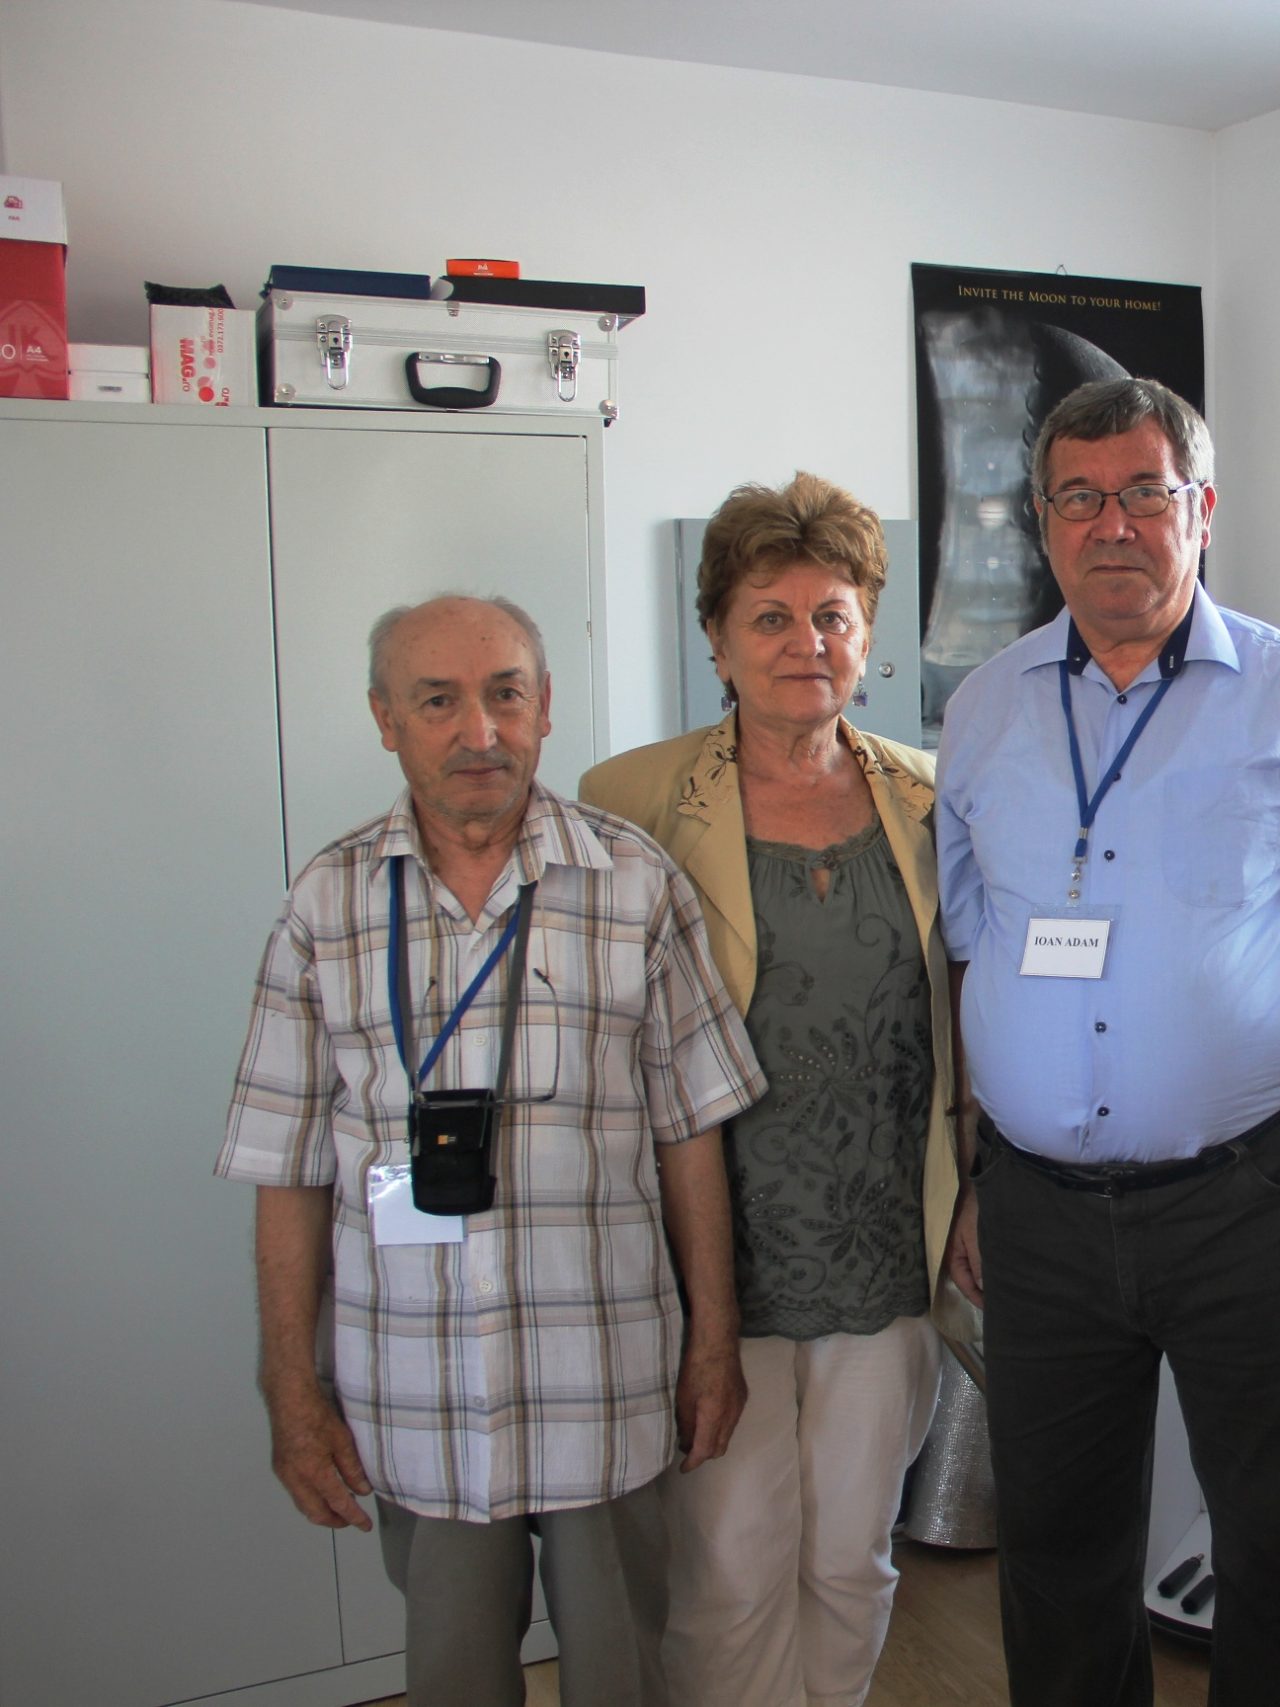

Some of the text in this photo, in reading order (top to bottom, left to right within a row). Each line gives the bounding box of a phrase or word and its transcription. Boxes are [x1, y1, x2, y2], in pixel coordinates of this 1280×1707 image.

[958, 285, 1162, 311] INVITE THE MOON TO YOUR HOME!
[26, 345, 43, 354] A4
[1034, 936, 1099, 948] IOAN ADAM
